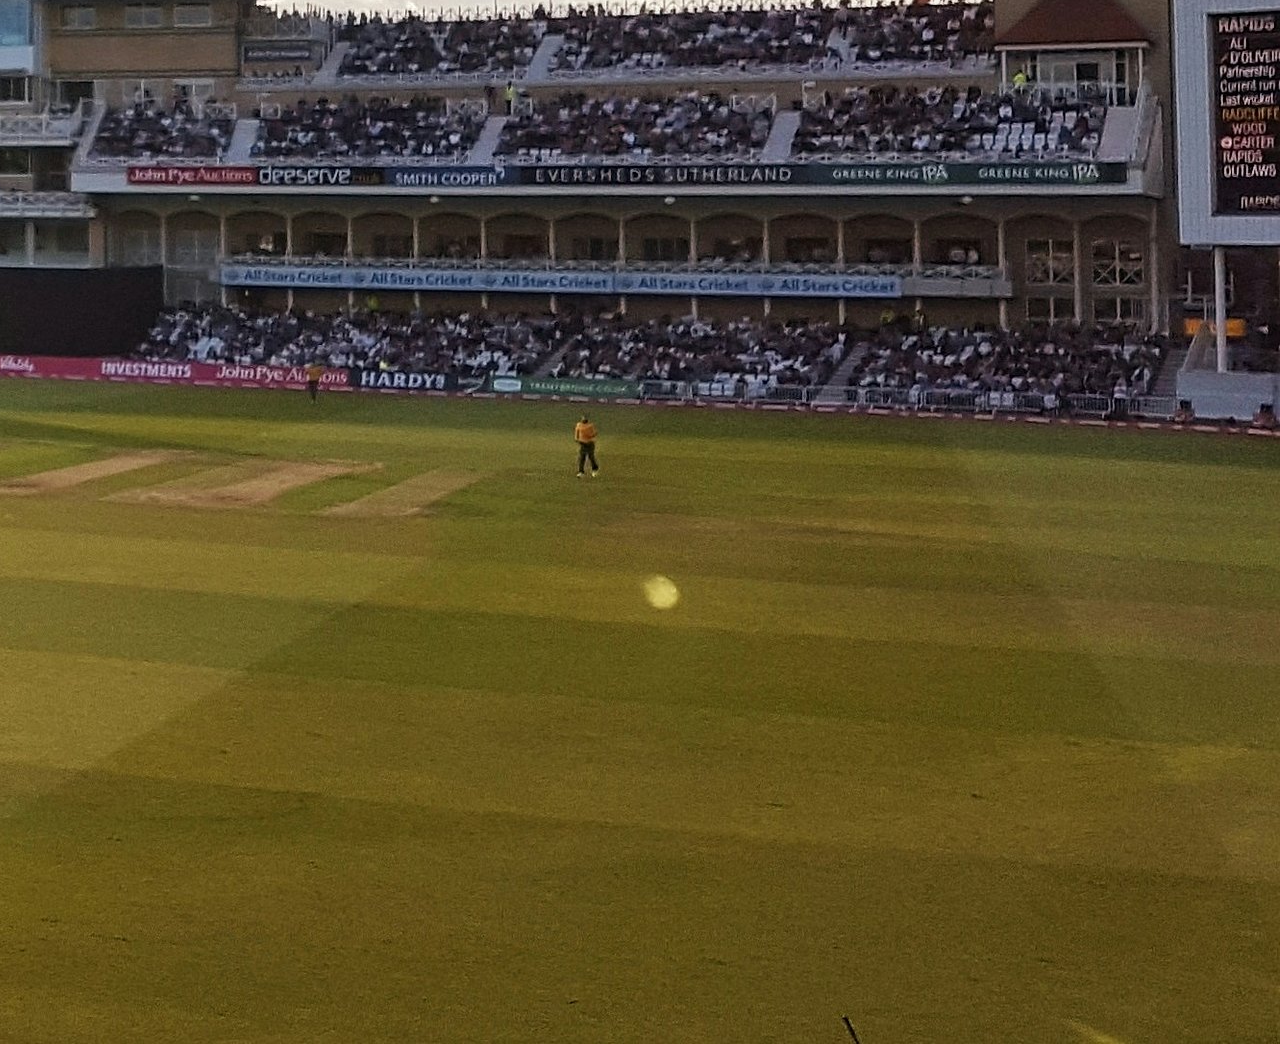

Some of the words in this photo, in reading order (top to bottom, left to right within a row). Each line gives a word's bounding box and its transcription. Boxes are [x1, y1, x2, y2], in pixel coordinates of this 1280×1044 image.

[1230, 37, 1247, 50] ALI
[1220, 65, 1276, 78] Partnership
[1220, 79, 1257, 93] Current
[1259, 80, 1276, 92] run
[1220, 94, 1241, 107] Last
[1243, 92, 1274, 106] wicket
[1232, 123, 1267, 135] WOOD
[1233, 137, 1275, 149] CARTER
[1223, 149, 1263, 163] RAPIDS
[131, 168, 166, 182] John
[168, 168, 195, 184] Pye
[196, 168, 253, 182] Auctions
[259, 166, 351, 185] deeserve
[535, 168, 656, 183] EVERSHEDS
[663, 168, 792, 183] SUTHERLAND
[832, 168, 881, 180] GREENE
[886, 168, 919, 180] KING
[922, 165, 948, 181] IPA
[978, 168, 1031, 180] GREENE
[1035, 168, 1069, 180] KING
[1072, 165, 1099, 181] IPA
[1224, 164, 1277, 178] OUTLAWS
[395, 172, 438, 185] SMITH
[441, 172, 497, 186] COOPER
[297, 271, 342, 283] Cricket
[371, 272, 389, 284] All
[390, 272, 423, 286] Stars
[425, 274, 473, 287] Cricket
[501, 275, 519, 287] All
[522, 275, 557, 288] Stars
[559, 275, 607, 288] Cricket
[639, 277, 658, 289] All
[698, 278, 749, 291] Cricket
[780, 278, 799, 291] All
[801, 279, 839, 291] Stars
[841, 280, 896, 293] Cricket
[100, 360, 192, 378] INVESTMENTS
[216, 365, 255, 382] John
[255, 366, 283, 384] Pye
[360, 370, 446, 389] HARDYS
